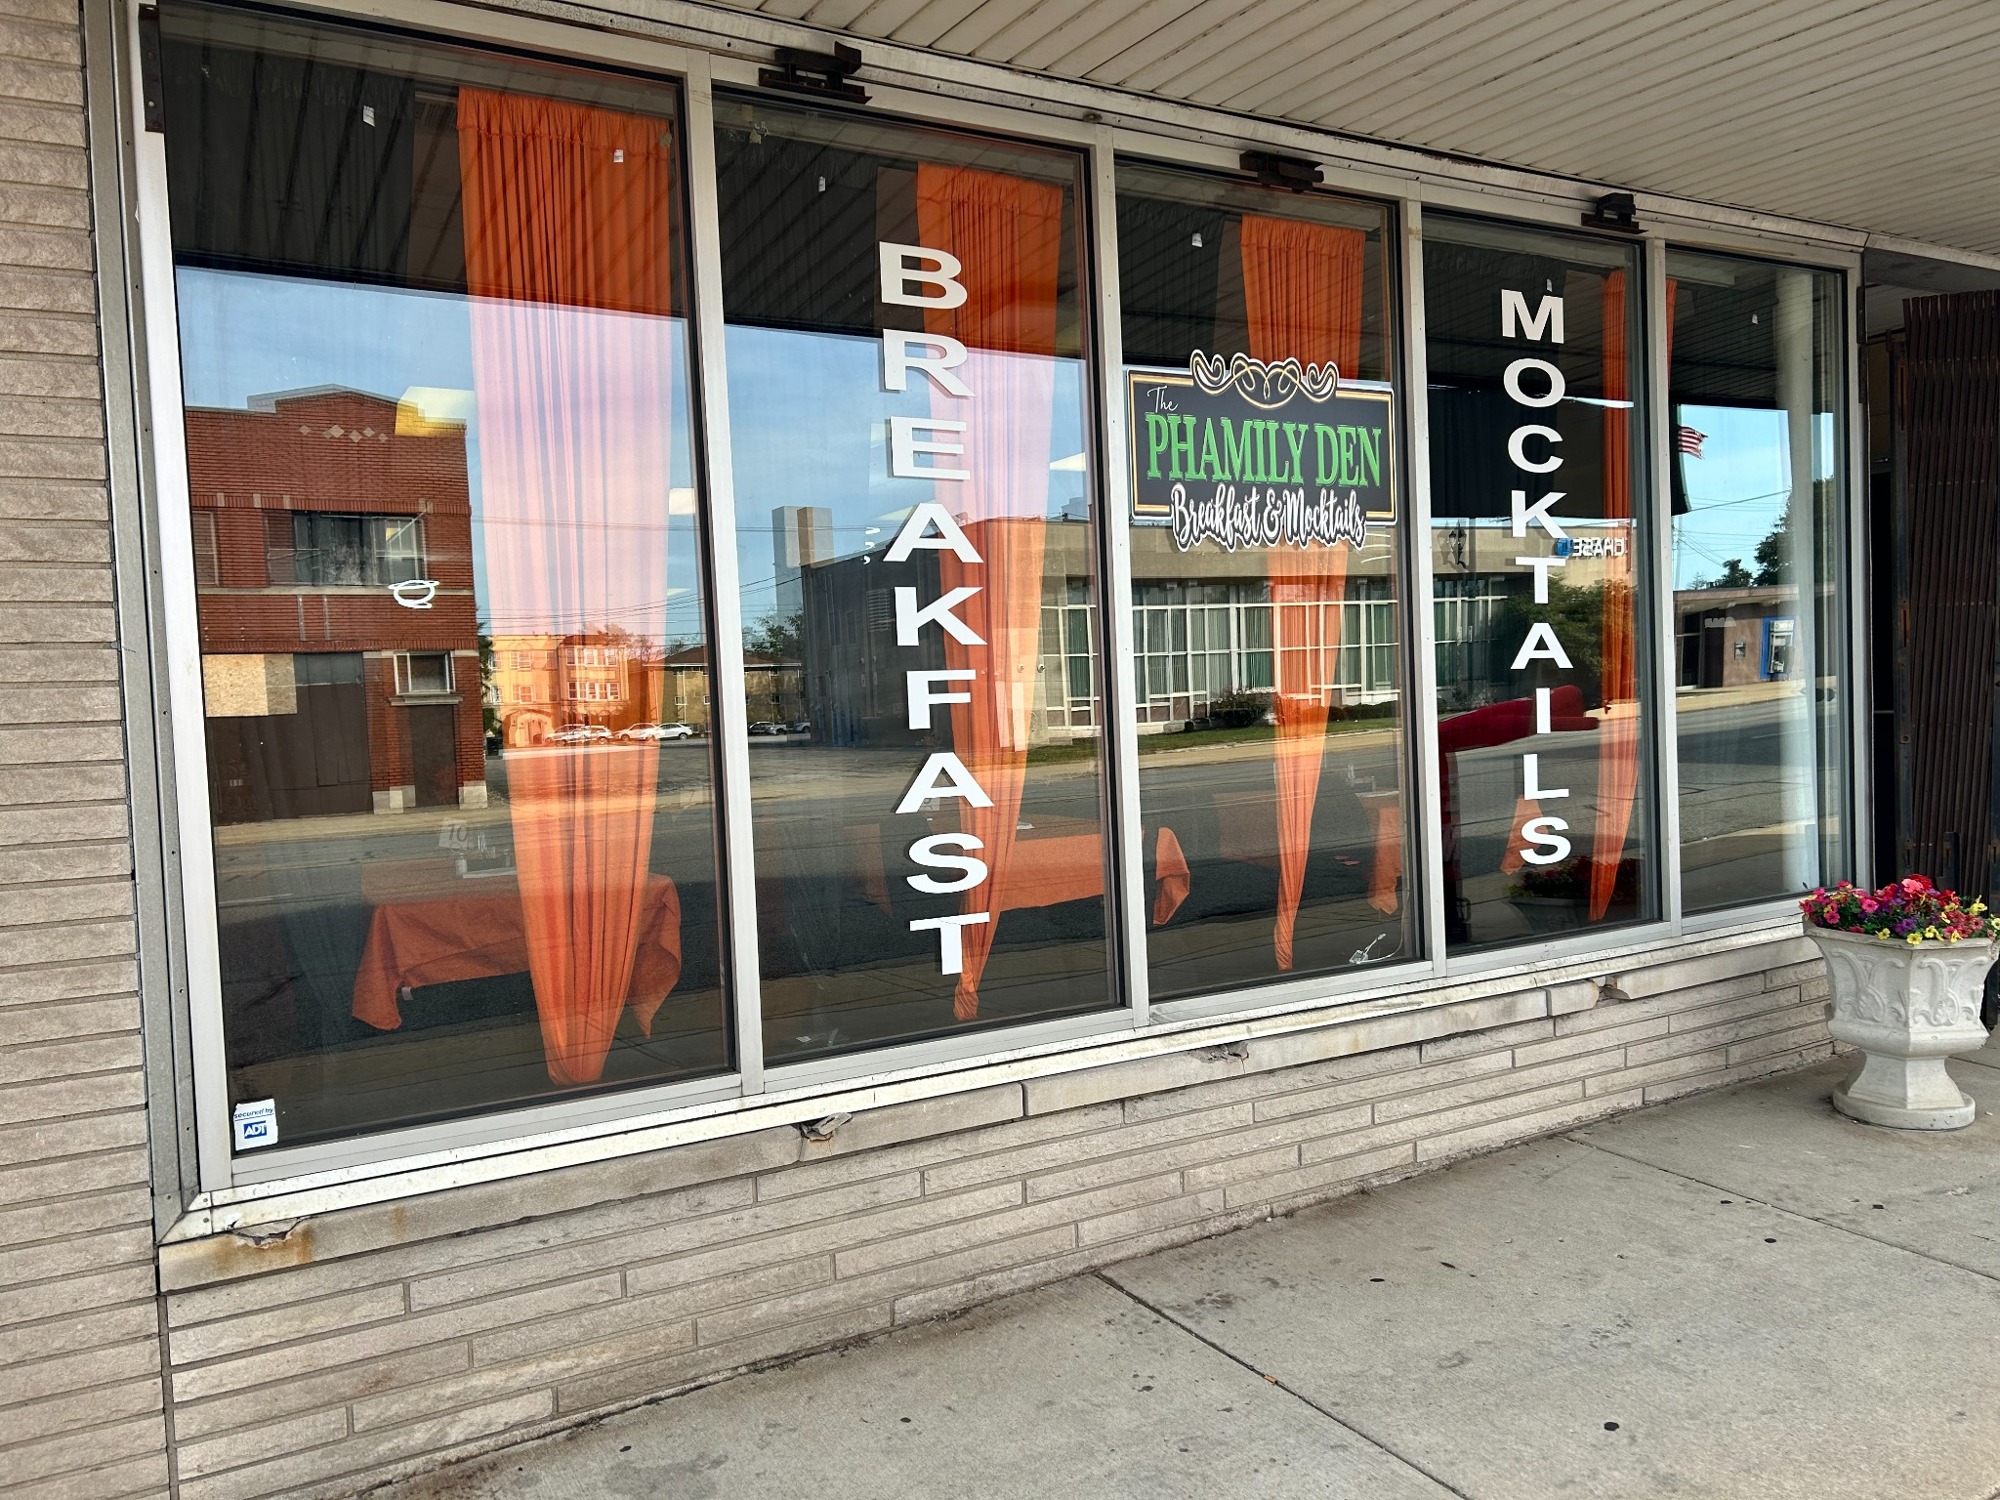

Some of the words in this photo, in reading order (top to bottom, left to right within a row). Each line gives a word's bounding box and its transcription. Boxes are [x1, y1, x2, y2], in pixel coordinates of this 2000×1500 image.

[1147, 385, 1179, 413] The
[1144, 412, 1309, 484] PHAMILY
[1315, 422, 1382, 488] DEN
[1170, 482, 1262, 552] Breakfast
[1261, 488, 1283, 541] &
[1282, 488, 1366, 551] Mocktails
[879, 241, 993, 976] BREAKFAST
[1501, 289, 1574, 865] MOCKTAILS
[244, 1123, 267, 1136] ADT
